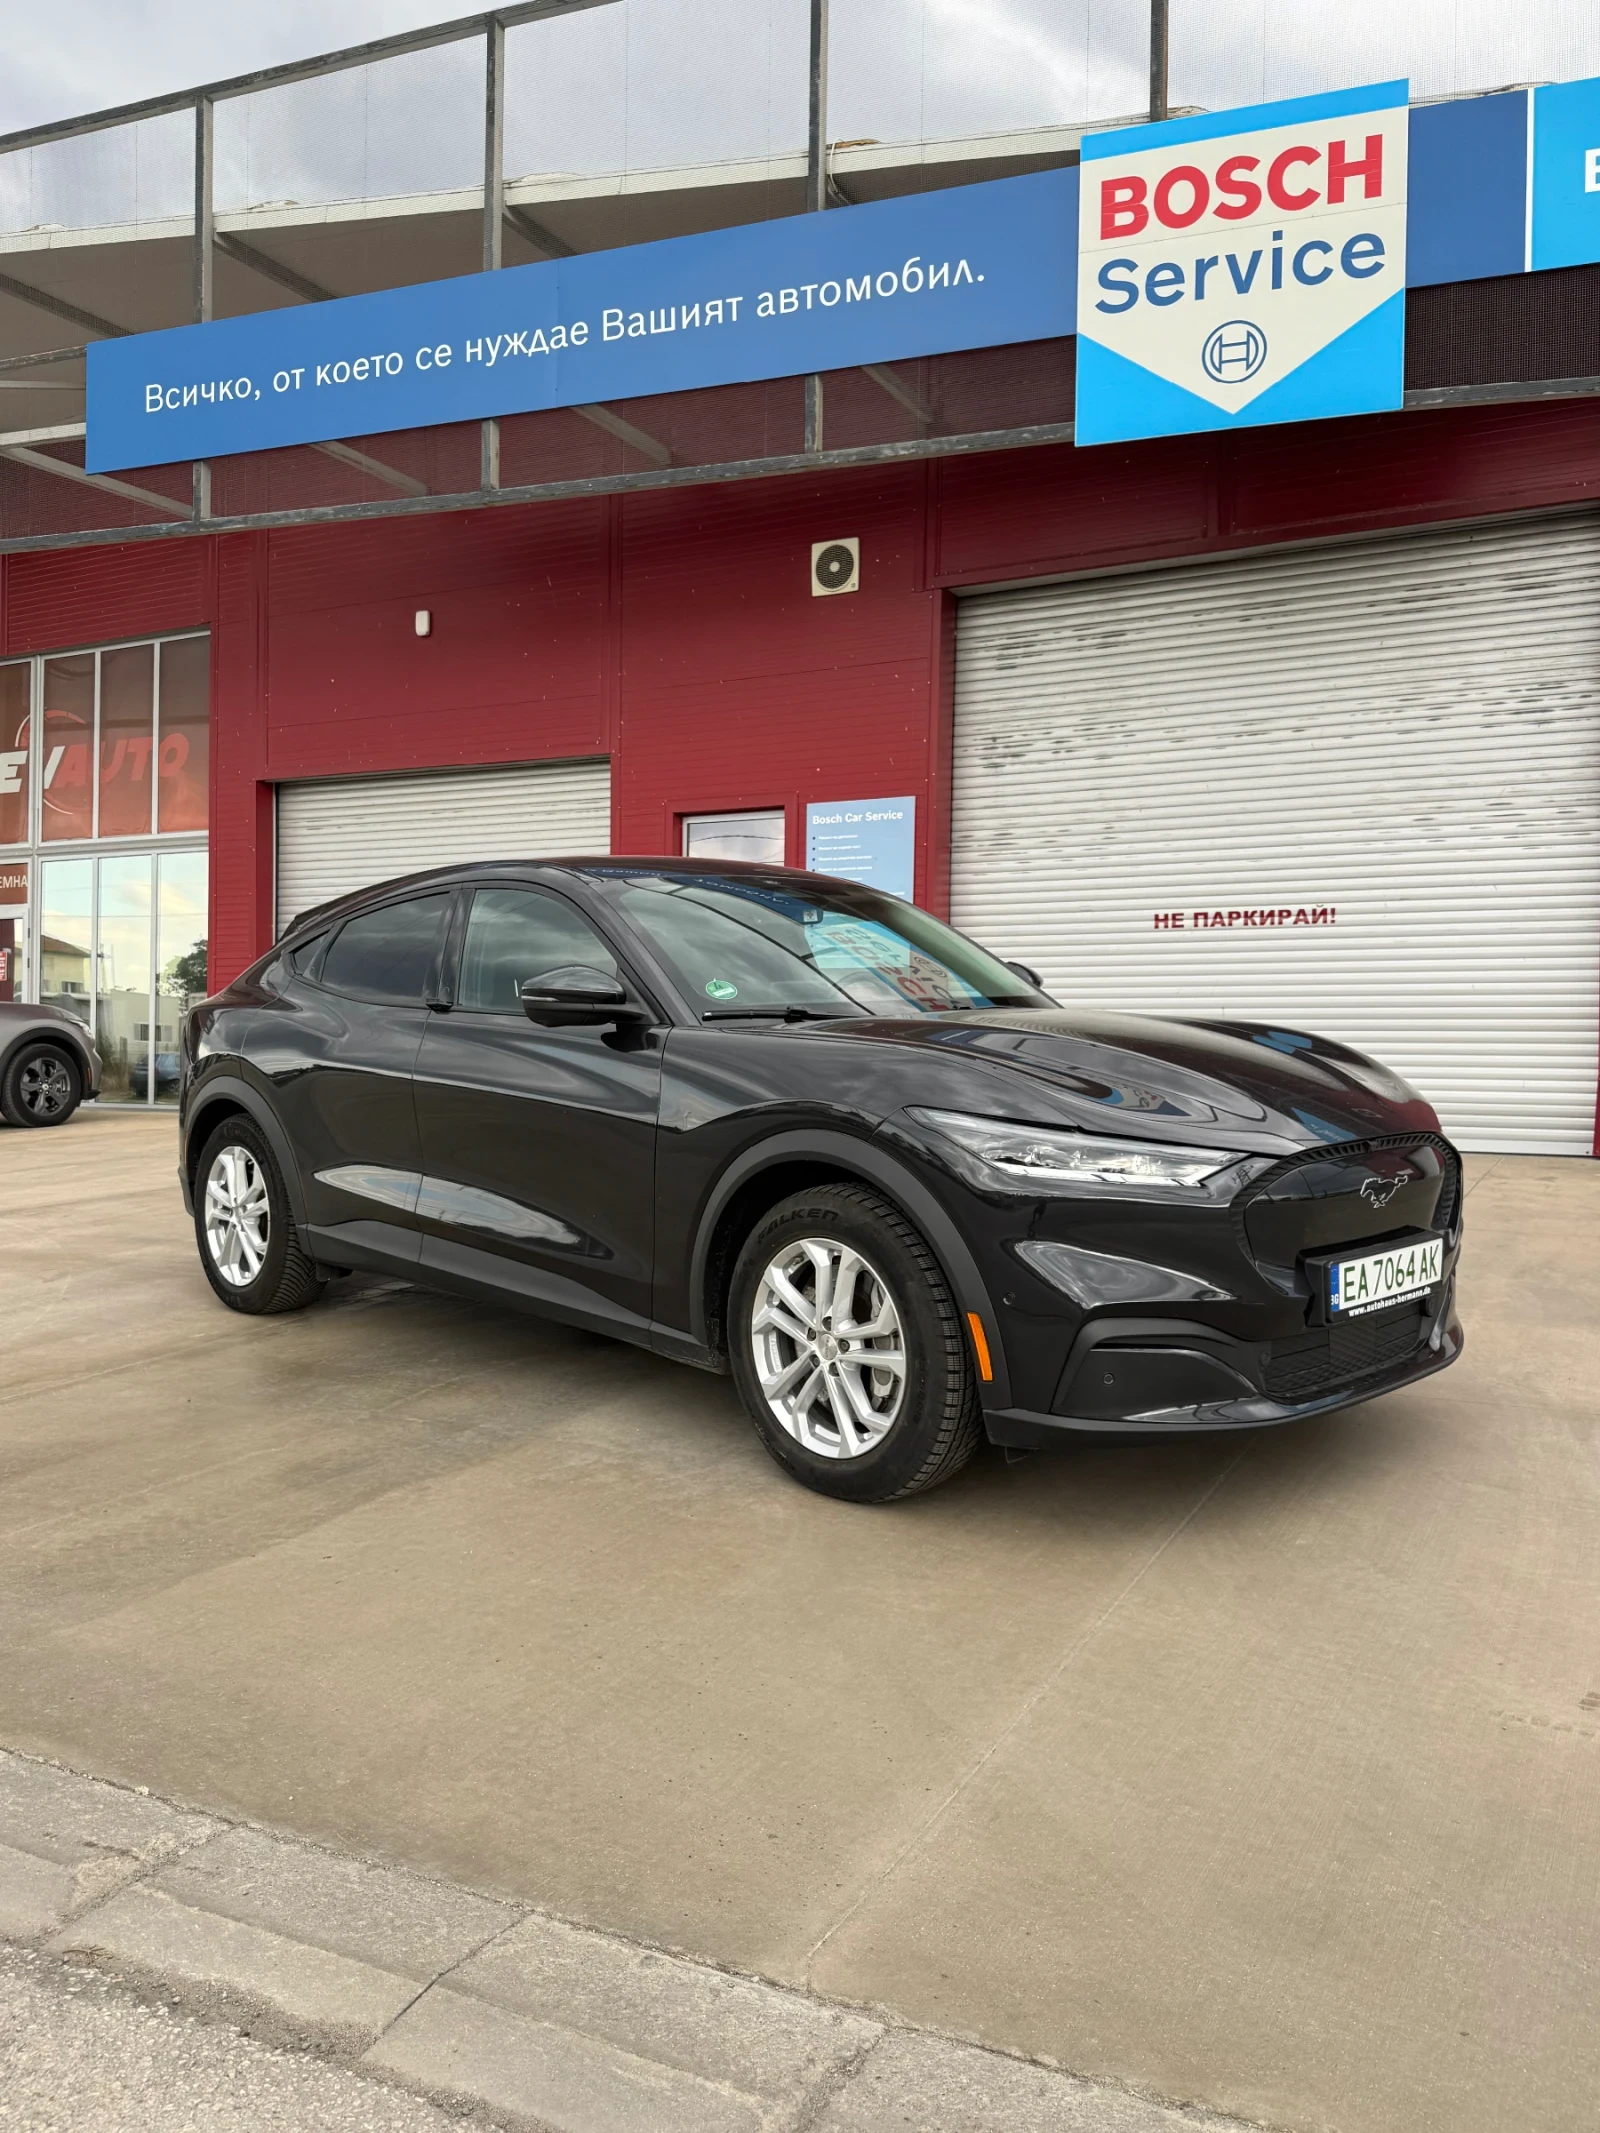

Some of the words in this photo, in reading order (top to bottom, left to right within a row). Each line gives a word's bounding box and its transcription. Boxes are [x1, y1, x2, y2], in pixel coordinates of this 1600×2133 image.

[1100, 134, 1383, 240] BOSCH
[1095, 230, 1385, 314] Service
[145, 377, 261, 413] Всичко,
[273, 368, 305, 393] от
[316, 352, 404, 387] което
[415, 344, 452, 370] се
[466, 321, 589, 367] нуждае
[602, 296, 744, 341] Вашият
[756, 256, 985, 317] автомобил.
[812, 813, 842, 825] Bosch
[845, 813, 863, 823] Car
[865, 810, 903, 821] Service
[1154, 912, 1184, 929] НЕ
[1193, 904, 1336, 928] ПАРКИРАЙ!
[756, 1207, 839, 1245] FALKEN
[1373, 1250, 1415, 1296] 7064
[1348, 1287, 1431, 1317] www.autohaus-hermann.de
